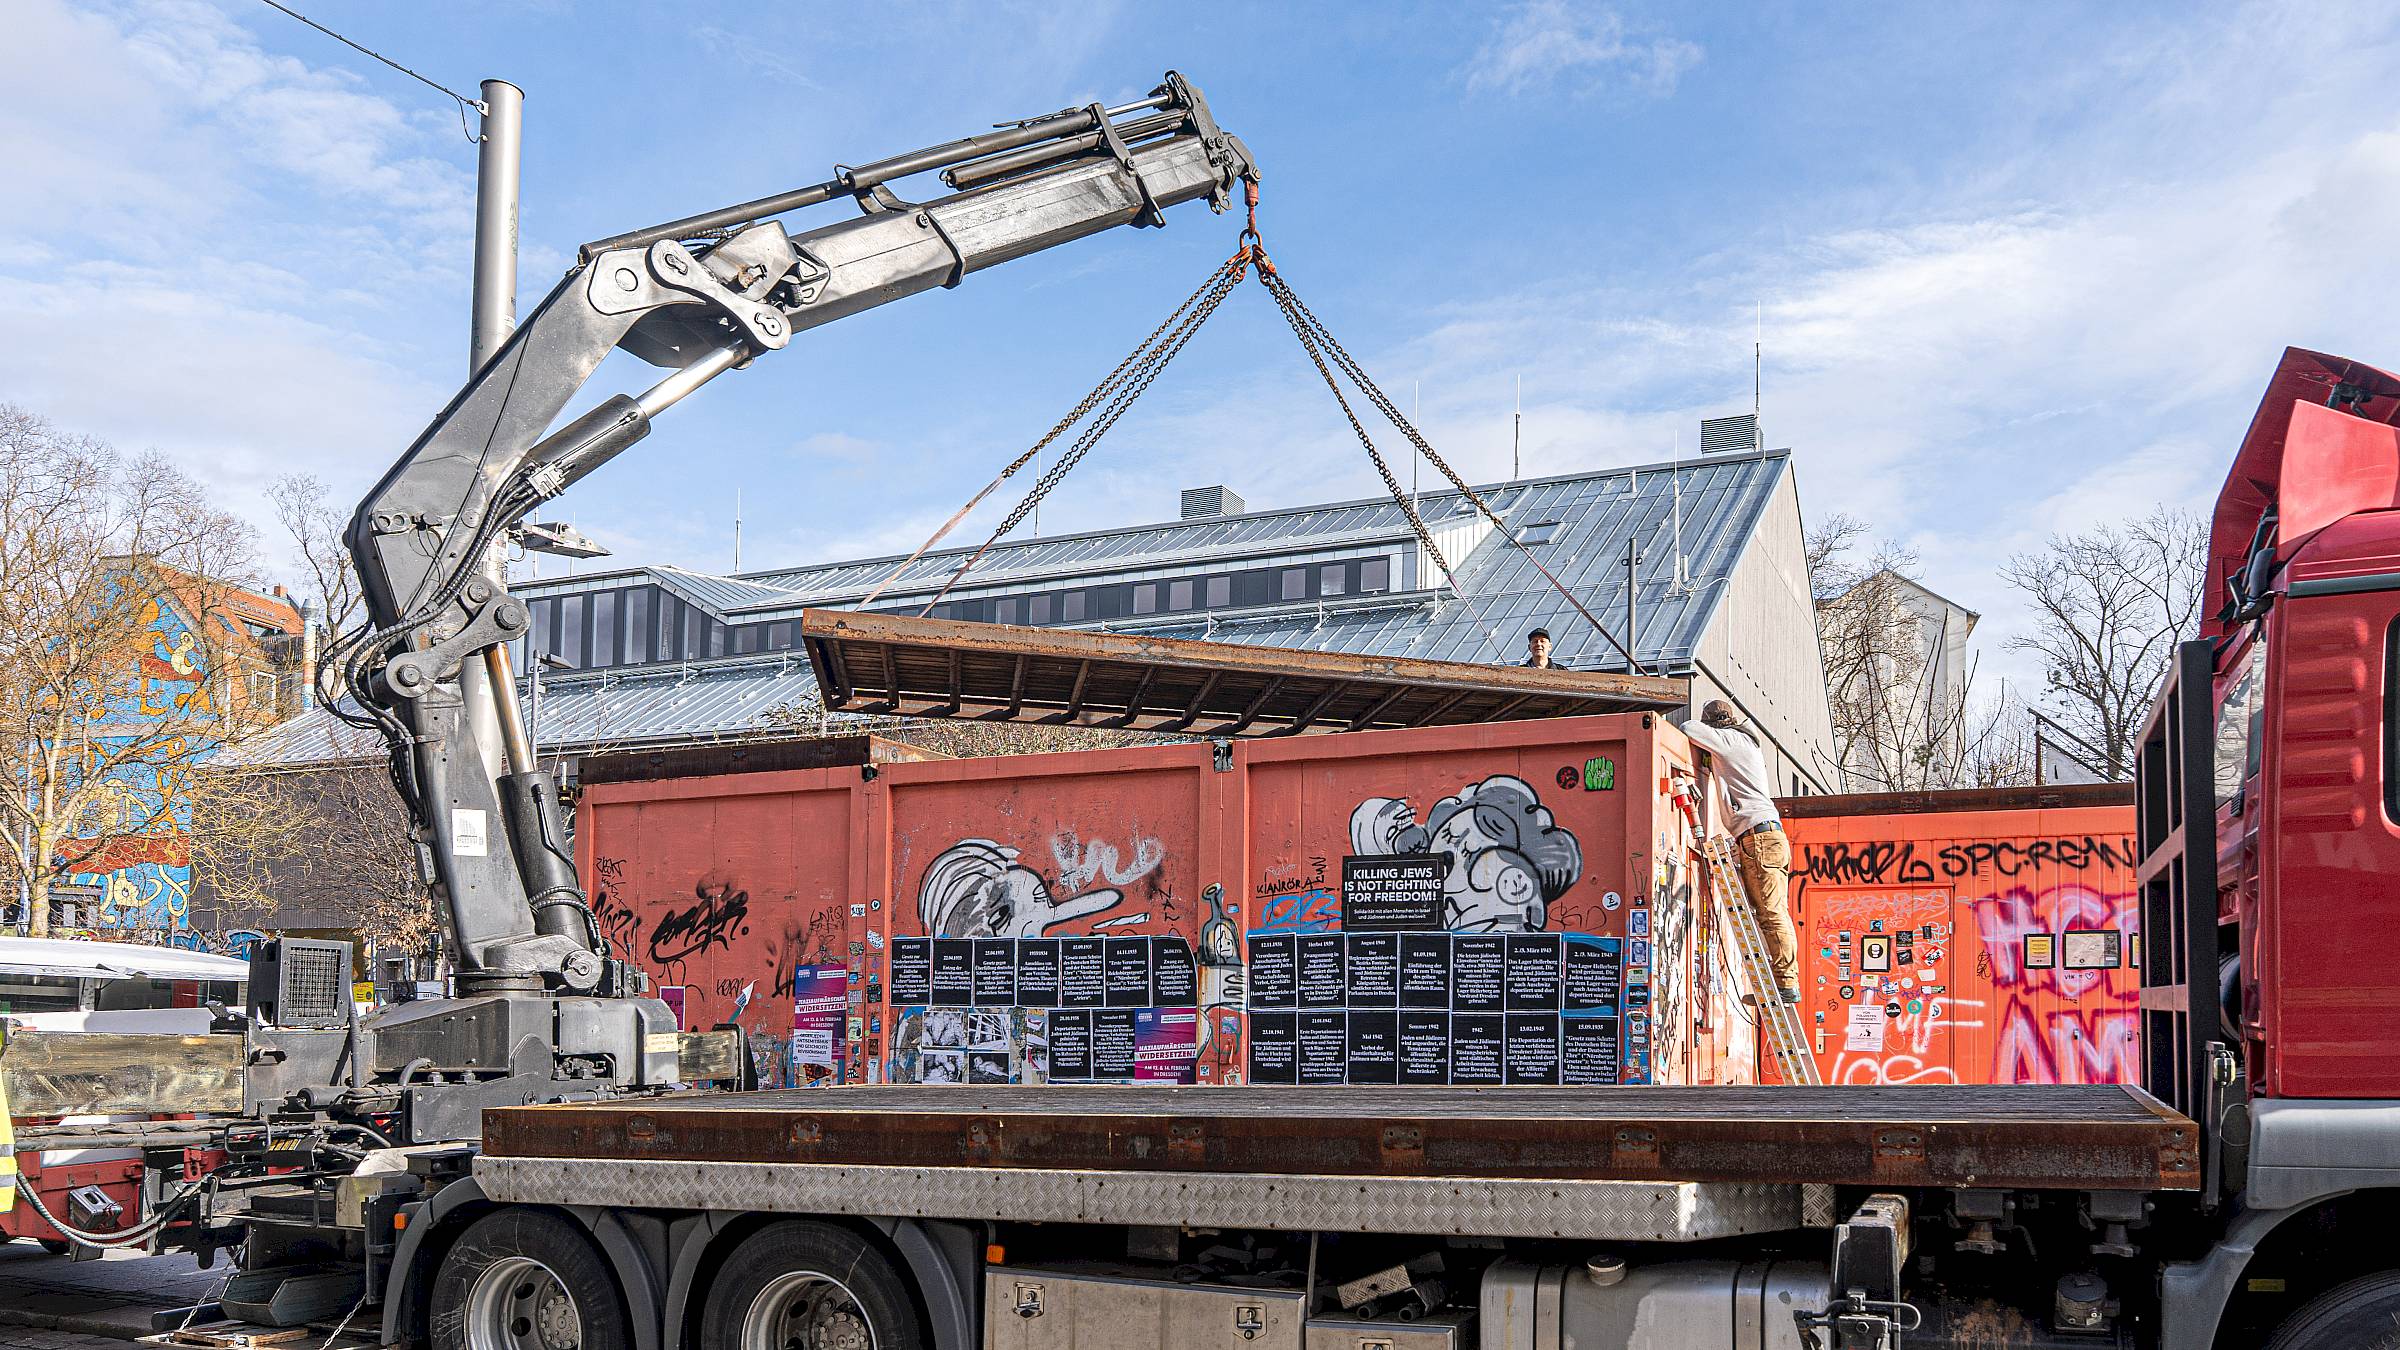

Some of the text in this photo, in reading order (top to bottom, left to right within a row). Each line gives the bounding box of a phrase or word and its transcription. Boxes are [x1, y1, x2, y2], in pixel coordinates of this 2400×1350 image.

[1353, 867, 1432, 879] KILLING JEWS
[1344, 879, 1441, 891] IS NOT FIGHTING
[1348, 891, 1436, 902] FOR FREEDOM!
[799, 1003, 846, 1012] WIDERSETZEN!
[1139, 1042, 1196, 1051] NAZIAUFMÄRSCHEN
[1139, 1050, 1195, 1059] WIDERSETZEN!
